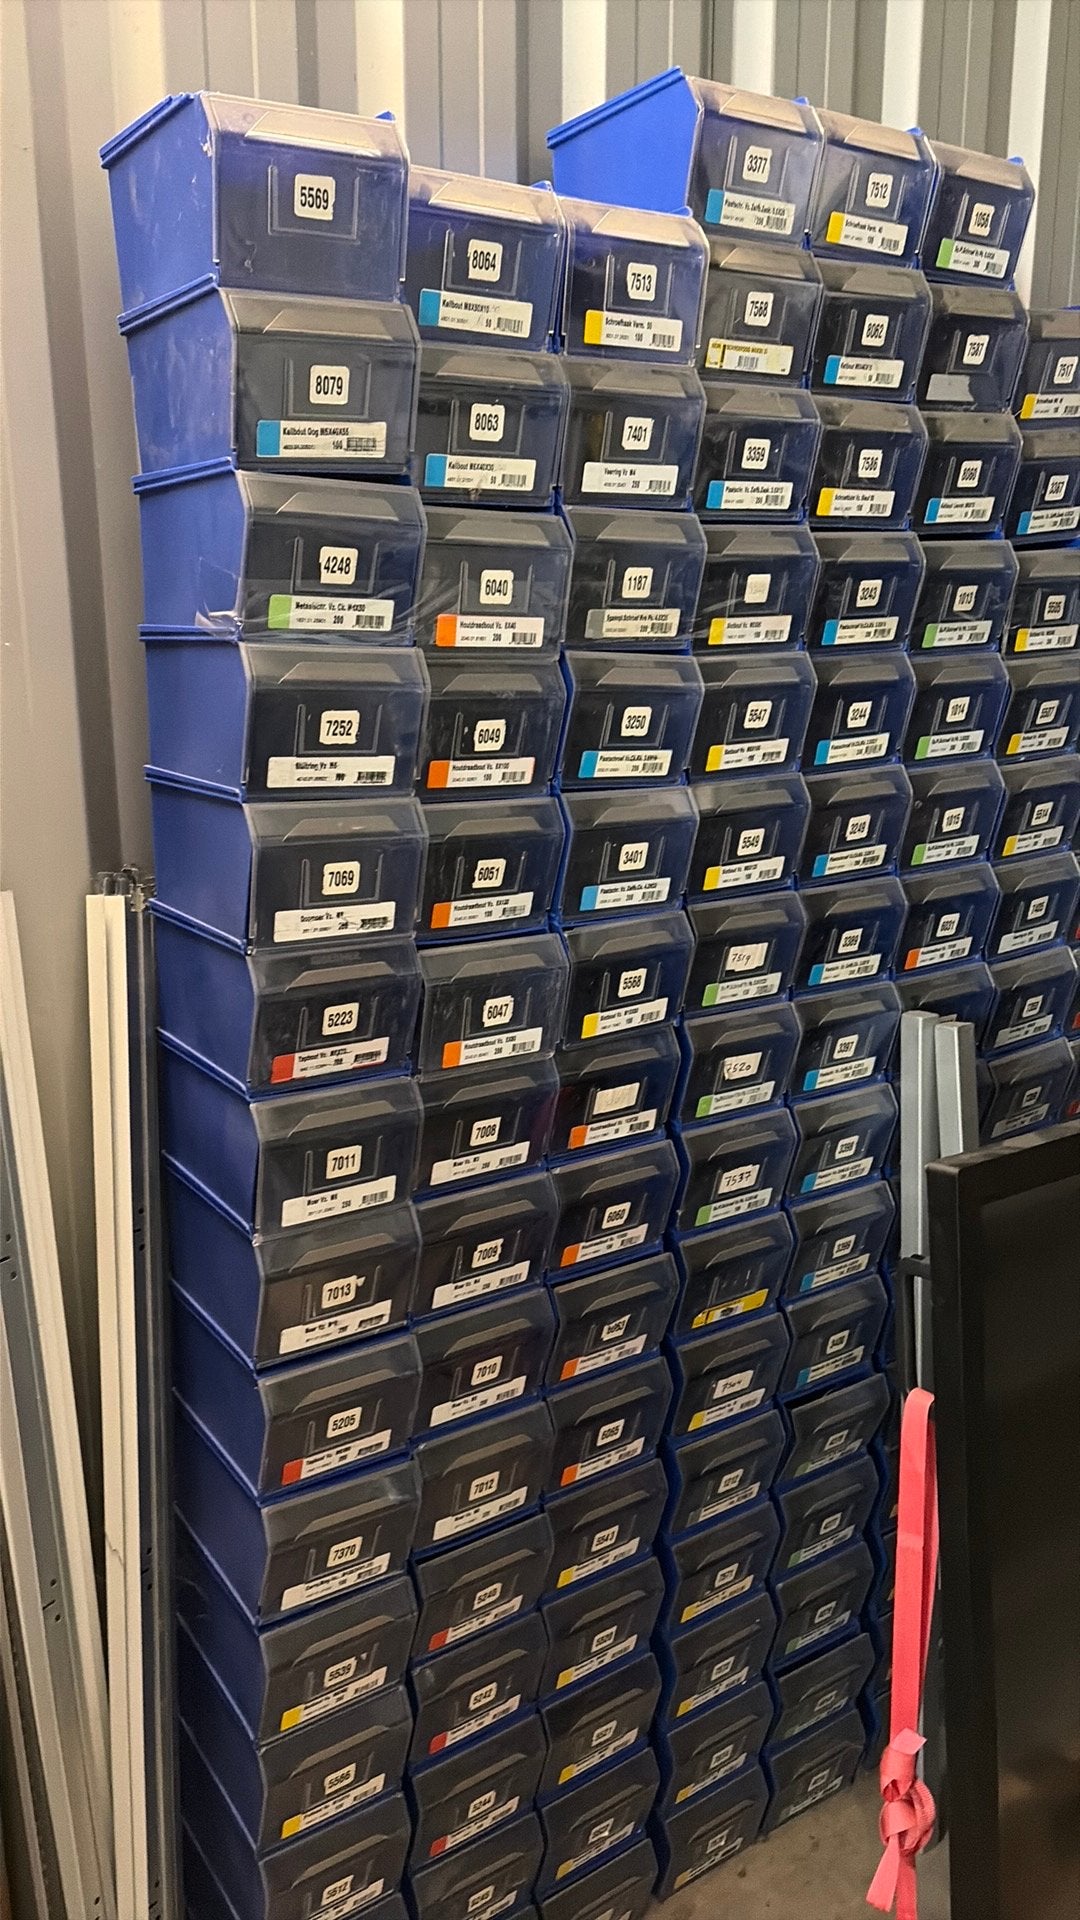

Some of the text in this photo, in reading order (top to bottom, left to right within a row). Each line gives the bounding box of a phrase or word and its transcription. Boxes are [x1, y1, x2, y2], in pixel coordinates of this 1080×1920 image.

[747, 154, 767, 174] 3377
[300, 186, 329, 211] 5569
[870, 180, 889, 200] 7512
[471, 250, 496, 271] 8064
[630, 273, 652, 292] 7513
[1057, 363, 1074, 377] 7517
[315, 375, 343, 396] 8079
[474, 414, 499, 432] 8063
[627, 425, 648, 443] 7401
[324, 557, 351, 575] 4248
[484, 578, 508, 597] 6040
[628, 575, 648, 591] 1187
[333, 615, 343, 625] 200
[625, 715, 647, 730] 3250
[748, 708, 767, 722] 5547
[325, 720, 353, 737] 7252
[477, 727, 501, 744] 6049
[741, 835, 760, 849] 5549
[623, 850, 643, 864] 3401
[328, 871, 354, 887] 7069
[478, 866, 499, 882] 6051
[622, 974, 642, 990] 5568
[327, 1009, 353, 1027] 5223
[487, 1003, 509, 1021] 6047
[727, 1062, 752, 1074] 7520
[475, 1124, 497, 1140] 7008
[332, 1154, 356, 1171] 7011
[724, 1170, 752, 1186] 7537
[477, 1246, 498, 1261] 7009
[327, 1283, 351, 1302] 7013
[477, 1362, 497, 1379] 7010
[332, 1414, 356, 1432] 5205
[474, 1479, 494, 1495] 7012
[333, 1544, 357, 1561] 7370
[329, 1663, 352, 1681] 5539
